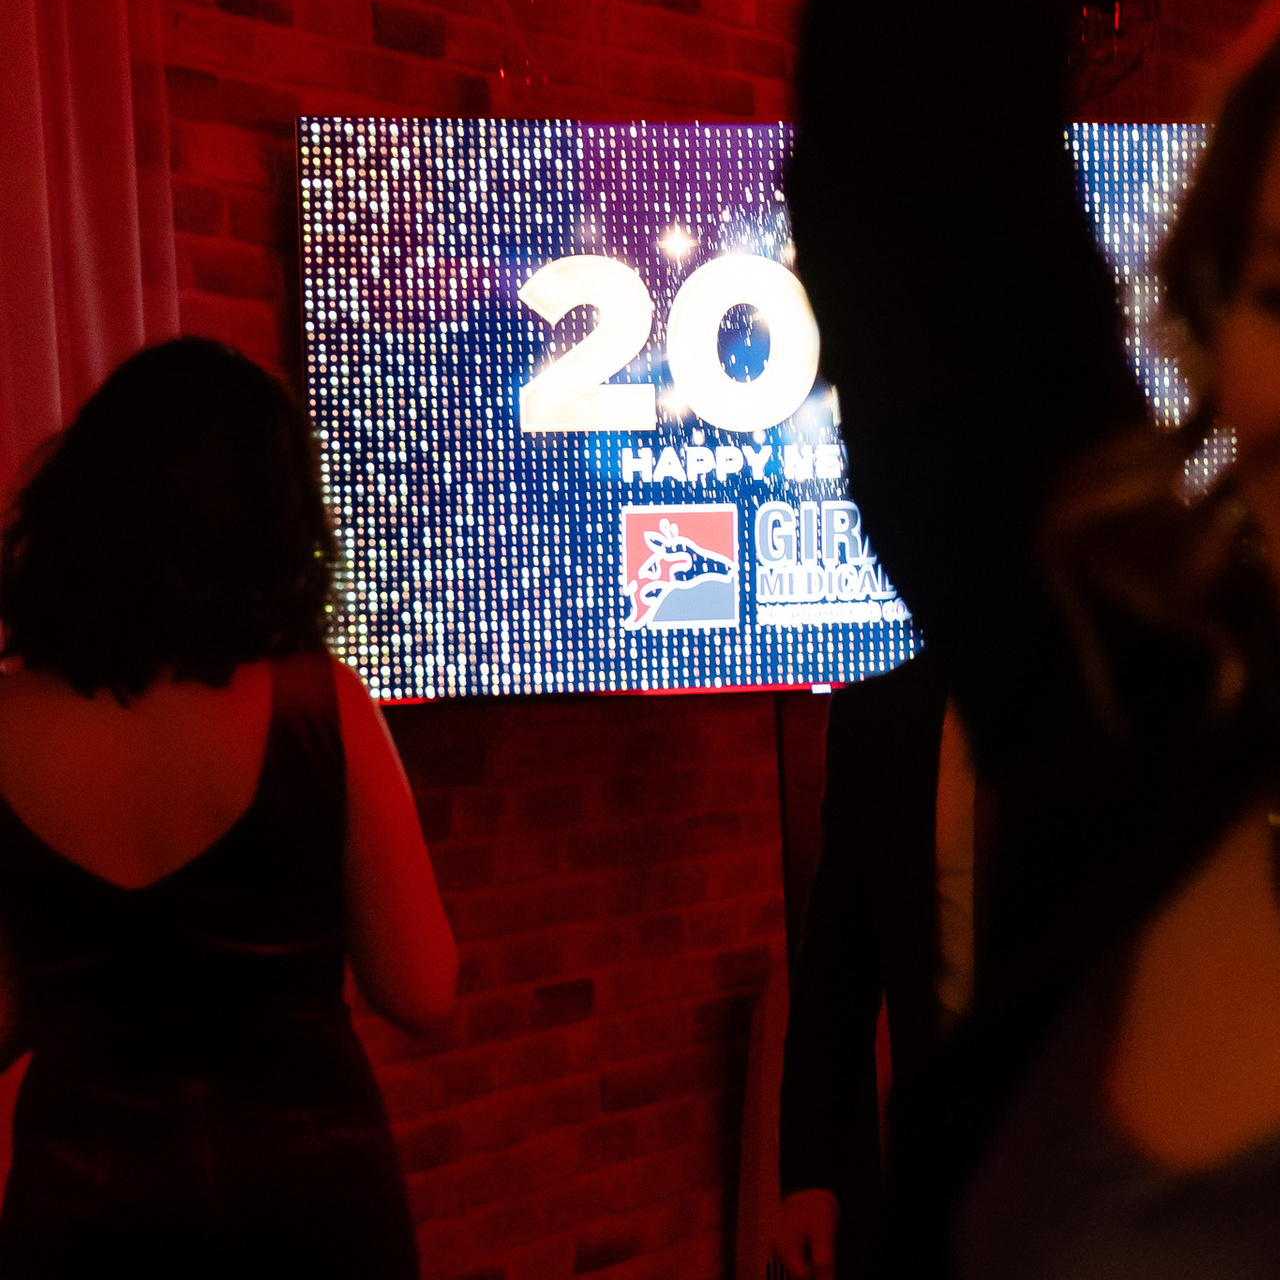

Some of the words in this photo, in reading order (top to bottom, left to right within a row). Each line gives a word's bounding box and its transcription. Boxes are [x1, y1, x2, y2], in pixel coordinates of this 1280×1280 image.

[517, 254, 841, 433] 20
[622, 445, 772, 483] HAPPY
[783, 444, 848, 480] NE
[755, 500, 876, 566] GIR
